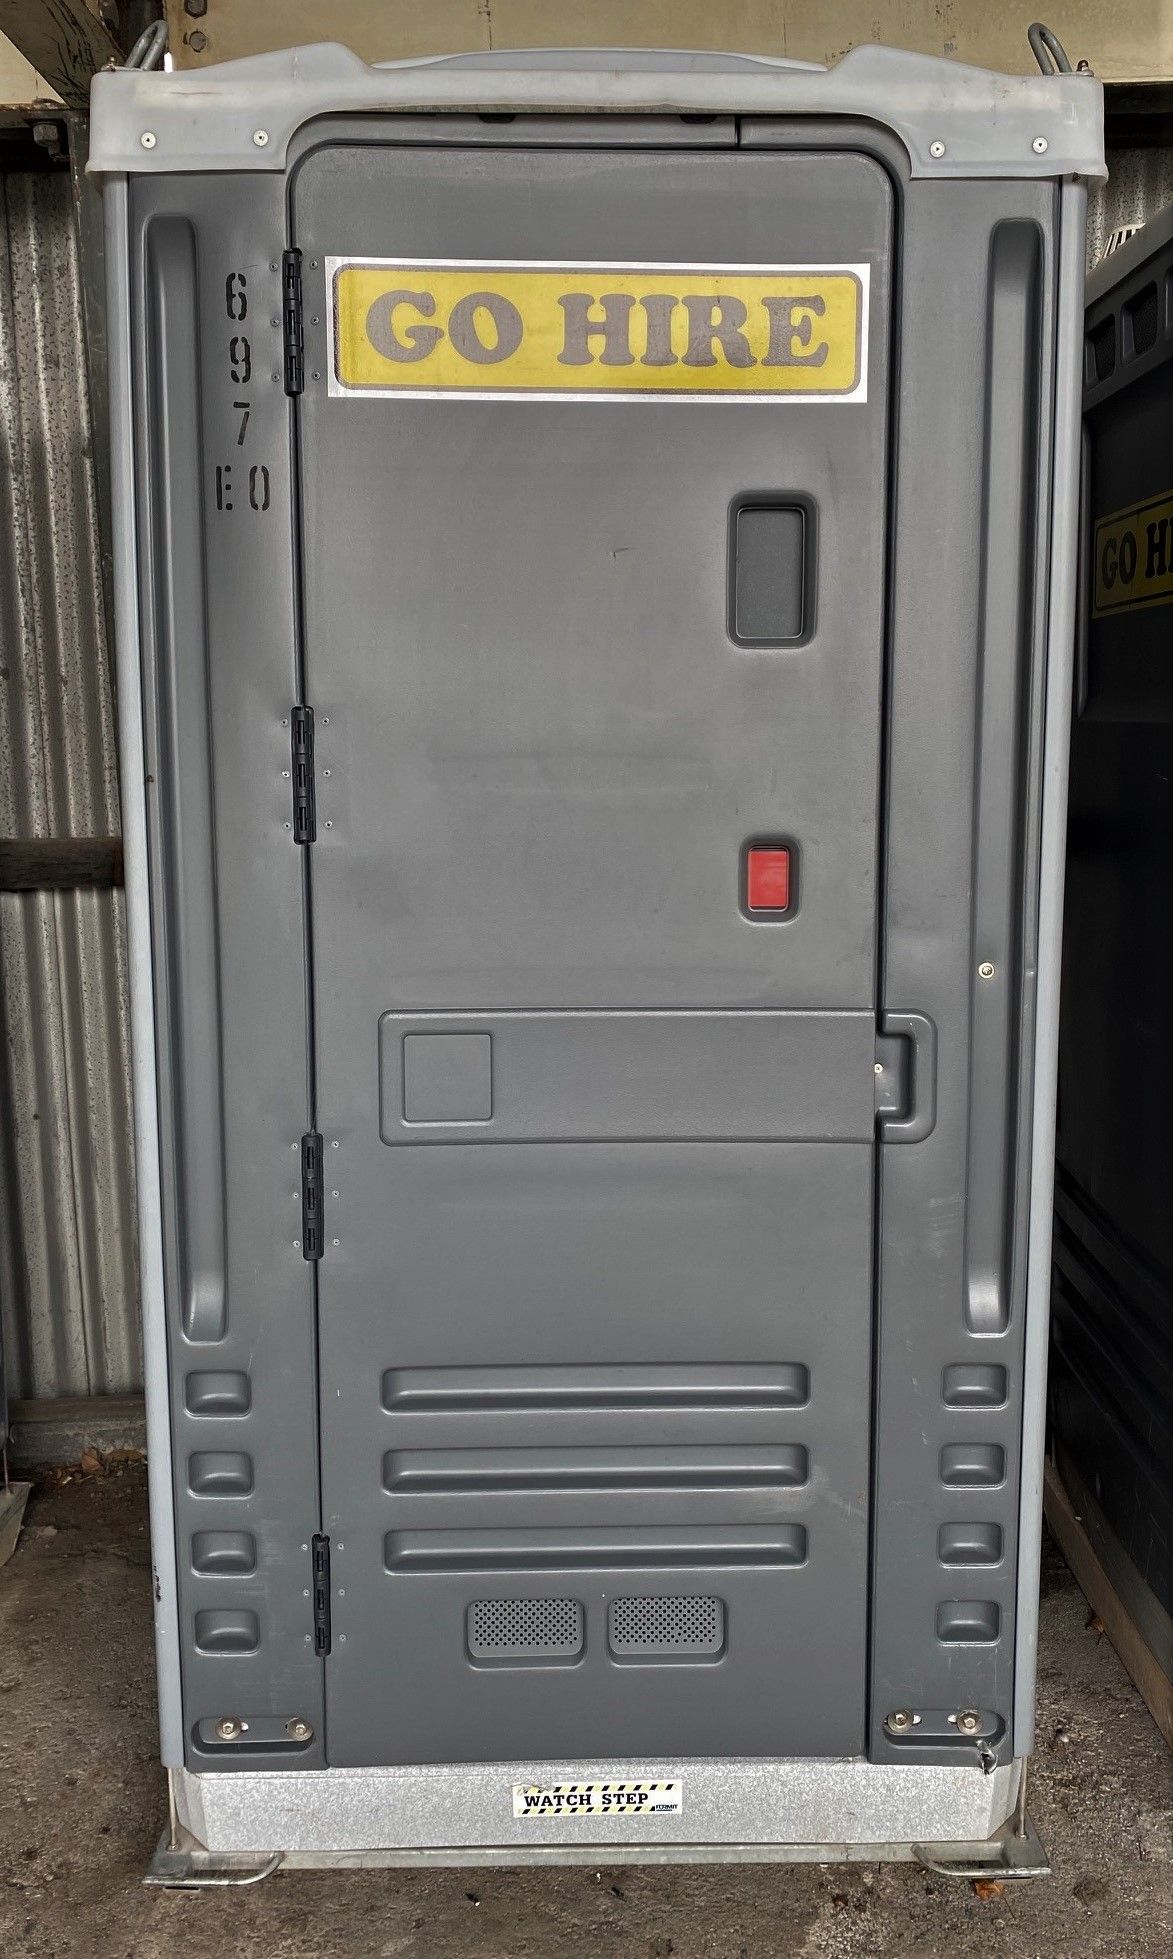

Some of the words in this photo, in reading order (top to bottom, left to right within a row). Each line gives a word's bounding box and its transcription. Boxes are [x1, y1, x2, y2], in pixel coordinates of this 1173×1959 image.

[365, 289, 524, 366] GO
[556, 292, 830, 369] HIRE
[1101, 530, 1138, 590] GO
[524, 1793, 592, 1807] WATCH
[601, 1792, 649, 1805] STEP
